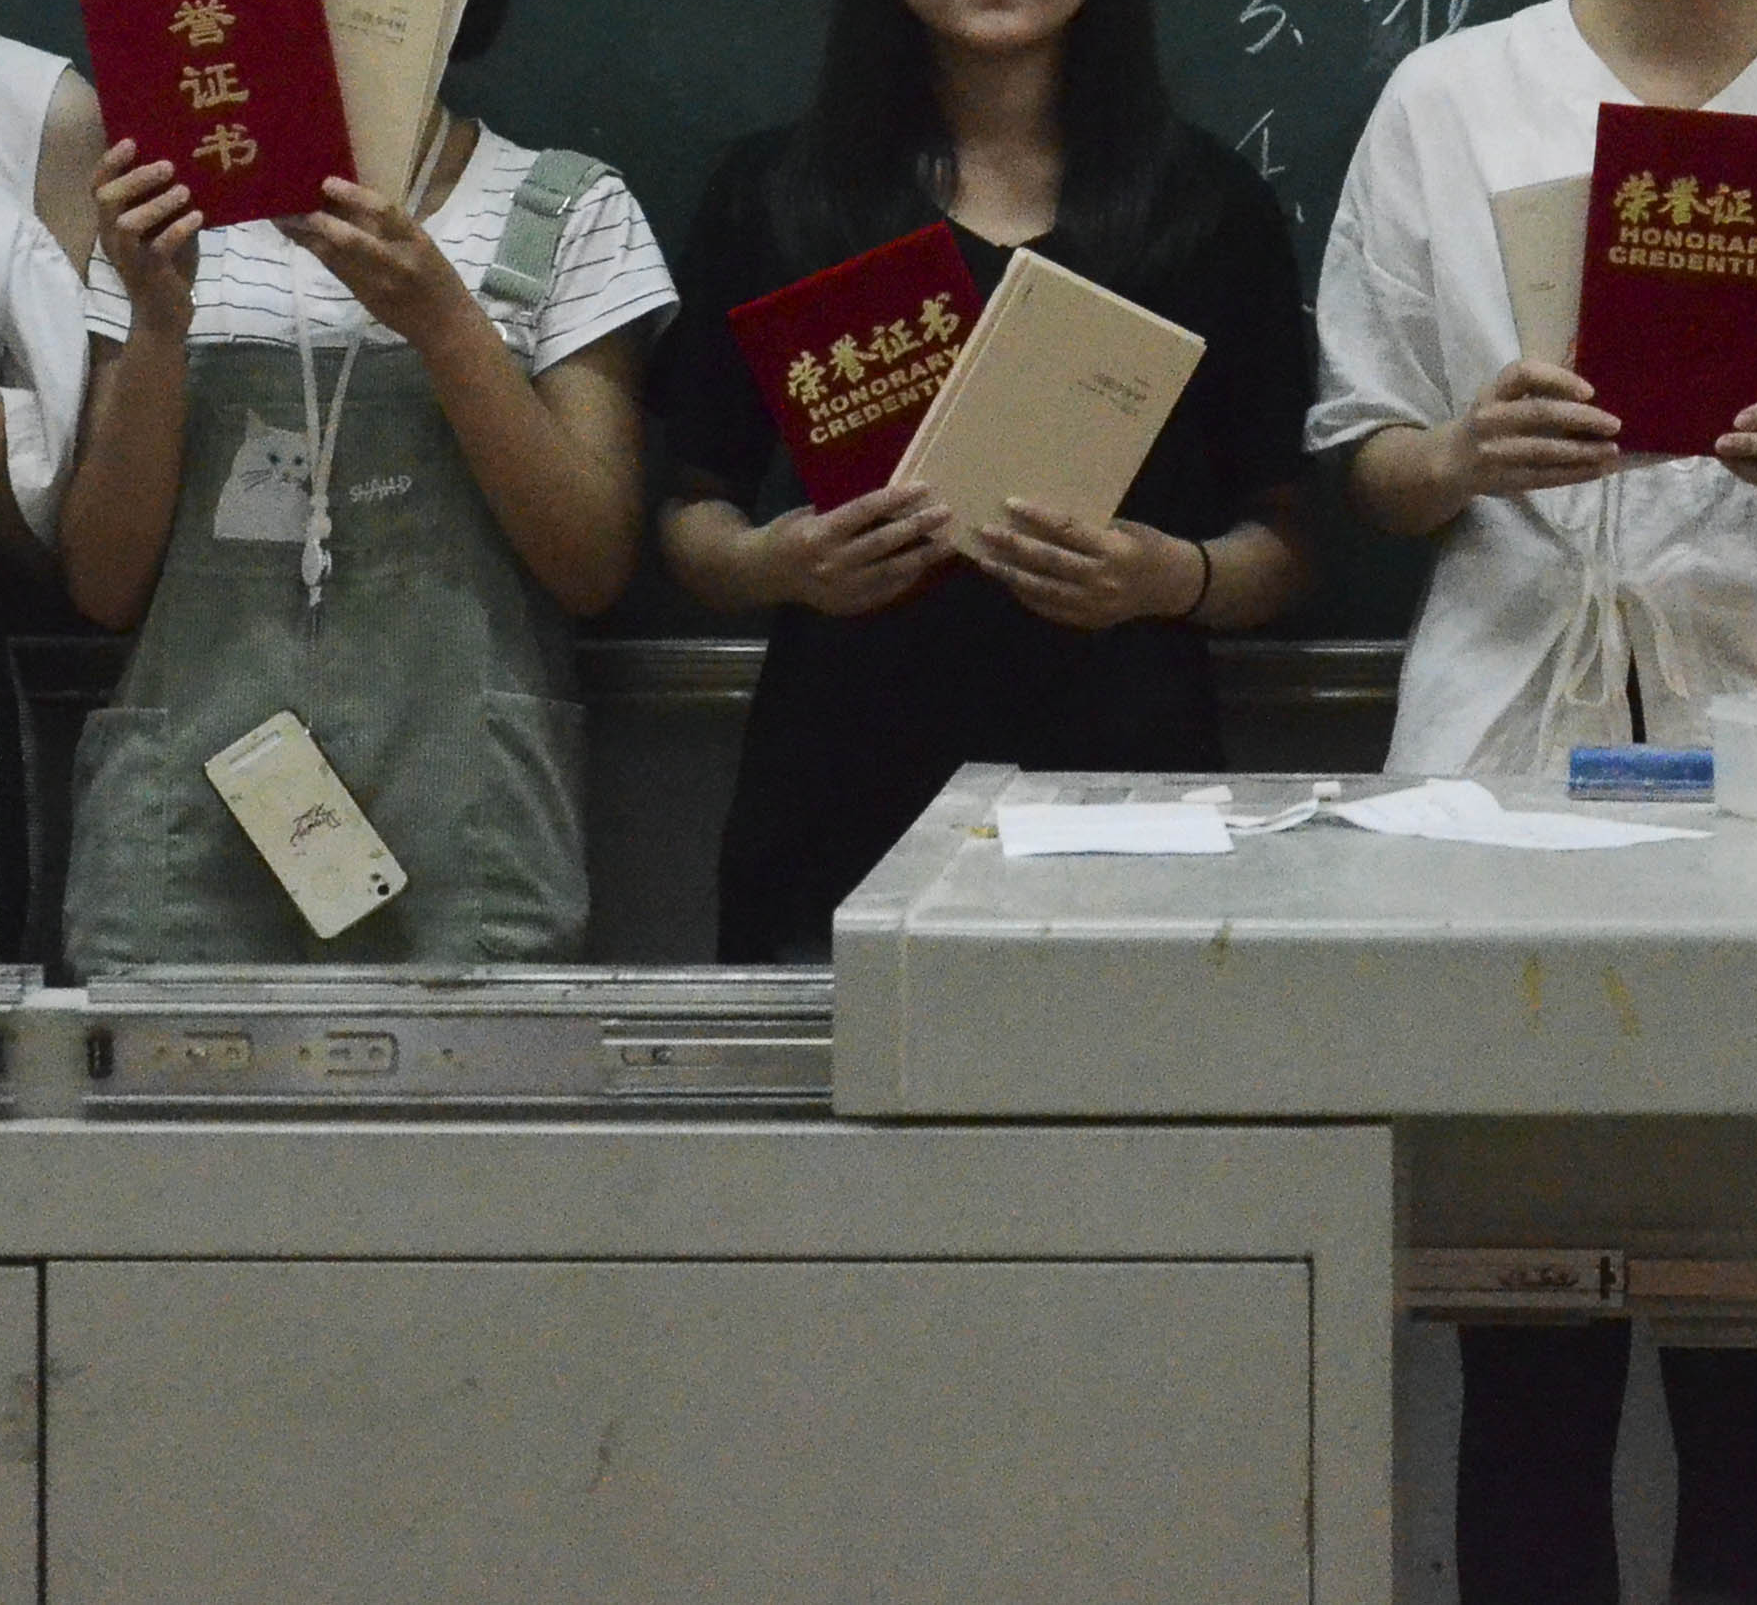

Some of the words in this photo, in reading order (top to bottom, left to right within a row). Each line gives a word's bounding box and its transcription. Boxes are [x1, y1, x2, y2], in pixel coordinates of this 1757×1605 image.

[787, 291, 961, 405] 荣誉证书
[809, 374, 946, 444] CREDENT
